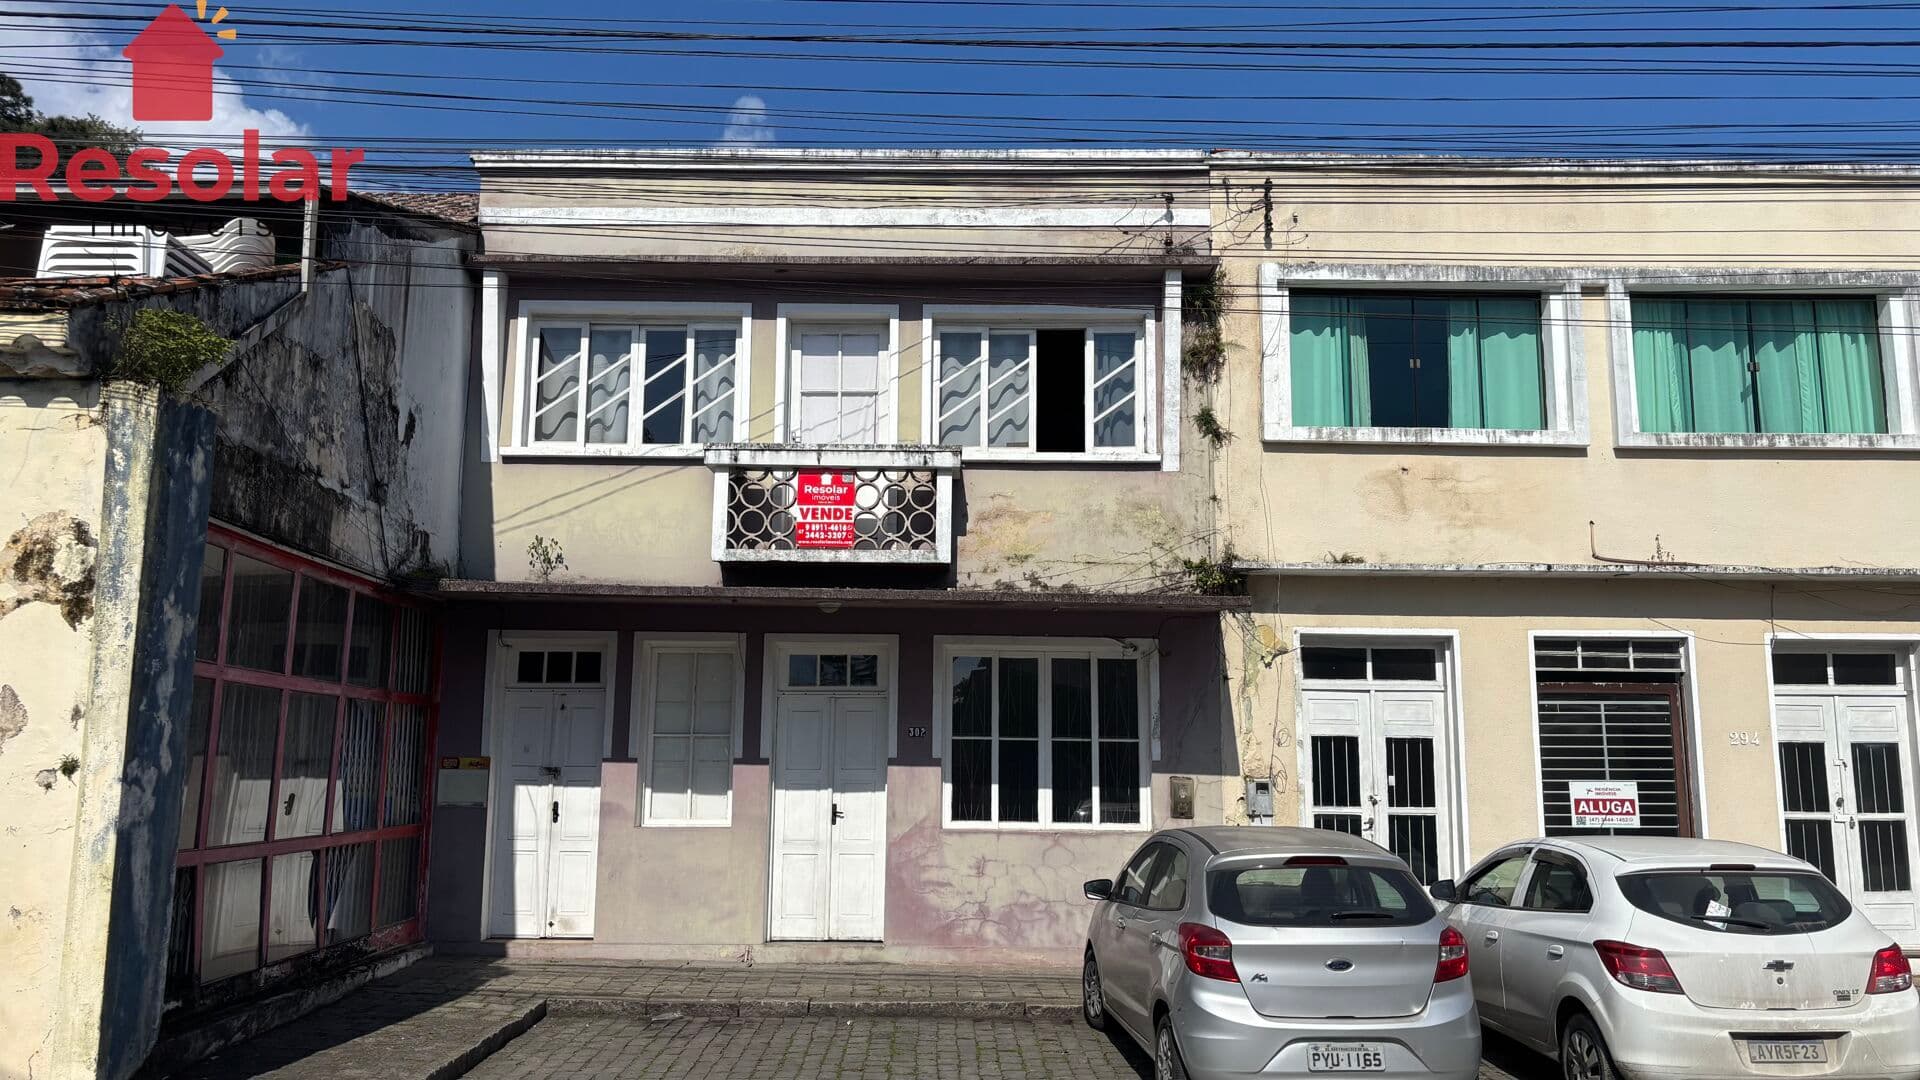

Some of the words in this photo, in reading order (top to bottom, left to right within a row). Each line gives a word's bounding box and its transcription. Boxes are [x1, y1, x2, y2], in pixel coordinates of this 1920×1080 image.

[804, 485, 848, 494] Resolar
[799, 508, 853, 521] VENDE
[1729, 731, 1760, 746] 294
[1578, 801, 1634, 814] ALUGA
[1758, 1044, 1819, 1060] AYR5F23
